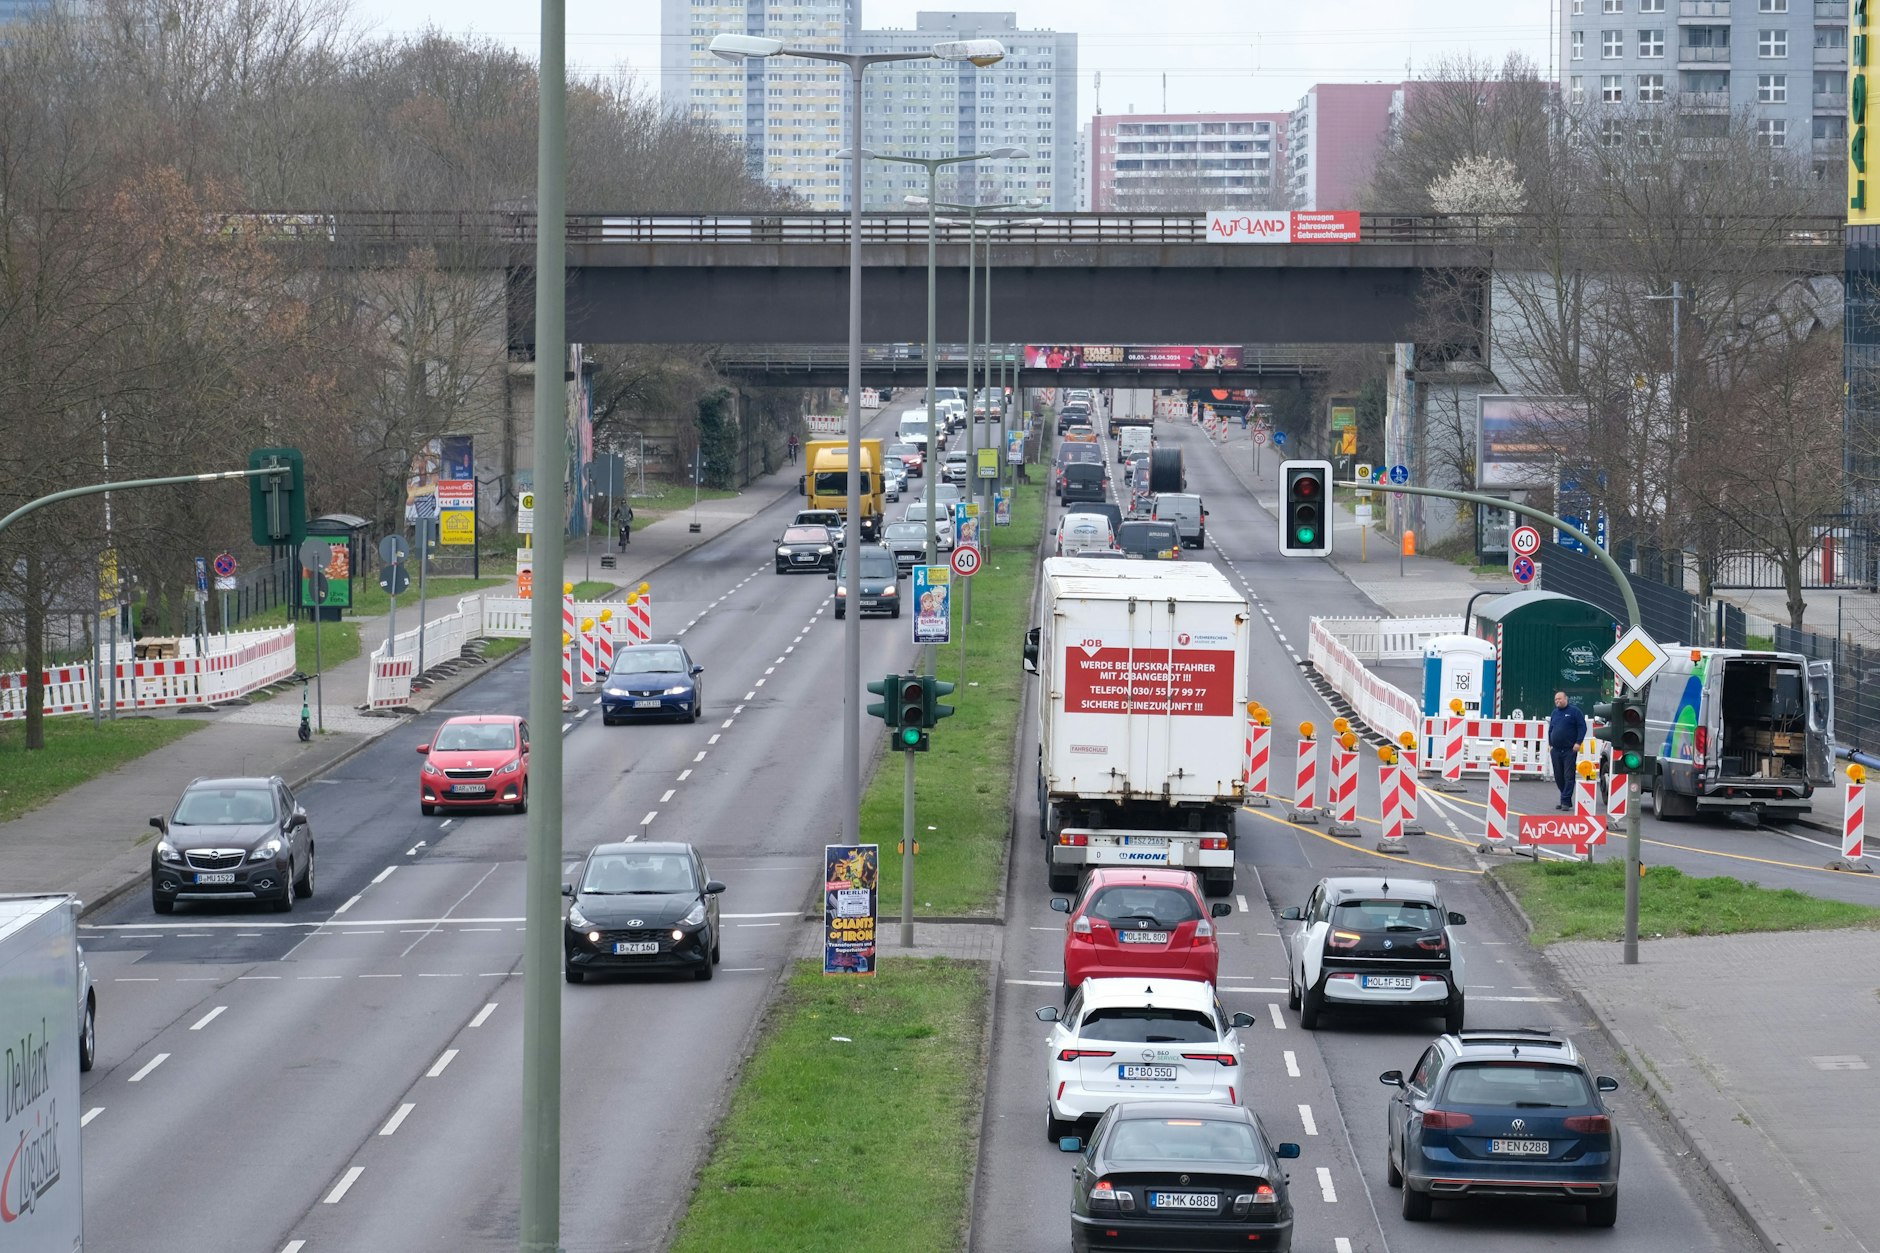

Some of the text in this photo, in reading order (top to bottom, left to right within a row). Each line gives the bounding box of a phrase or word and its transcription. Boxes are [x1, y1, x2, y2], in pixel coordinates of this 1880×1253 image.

[1297, 213, 1334, 221] Neuwagen
[1212, 217, 1285, 236] AUTOLAND
[1297, 222, 1344, 231] Jahreswagen
[1297, 231, 1356, 239] Gebrauchtwagen
[1083, 347, 1124, 355] STARS IN
[1083, 354, 1124, 362] CONCERT
[1518, 534, 1533, 547] 60
[957, 554, 975, 567] 60
[1080, 639, 1103, 647] JOB
[1080, 661, 1113, 670] WERDE
[1100, 671, 1192, 682] MIT JOBANGEBOT !!!
[1090, 685, 1130, 695] TELEFON
[1155, 687, 1167, 696] 55
[1182, 688, 1194, 697] 99
[1195, 688, 1207, 697] 77
[1456, 682, 1469, 690] TOI
[1081, 700, 1119, 709] SICHERE
[1194, 702, 1204, 711] !!!
[1514, 711, 1521, 719] 25
[1522, 820, 1589, 839] AUTOLAND
[831, 917, 874, 930] GIANTS
[842, 930, 873, 942] IRON
[1124, 932, 1166, 942] MOL RL 809
[619, 943, 656, 952] B ZT 160
[1367, 977, 1411, 987] MOL F 51E
[5, 1017, 49, 1124] DeMark
[1128, 1067, 1172, 1077] B BO 550
[1493, 1141, 1548, 1152] B EN 6288
[18, 1097, 61, 1215] Logistik
[1158, 1194, 1217, 1207] B MK 6888
